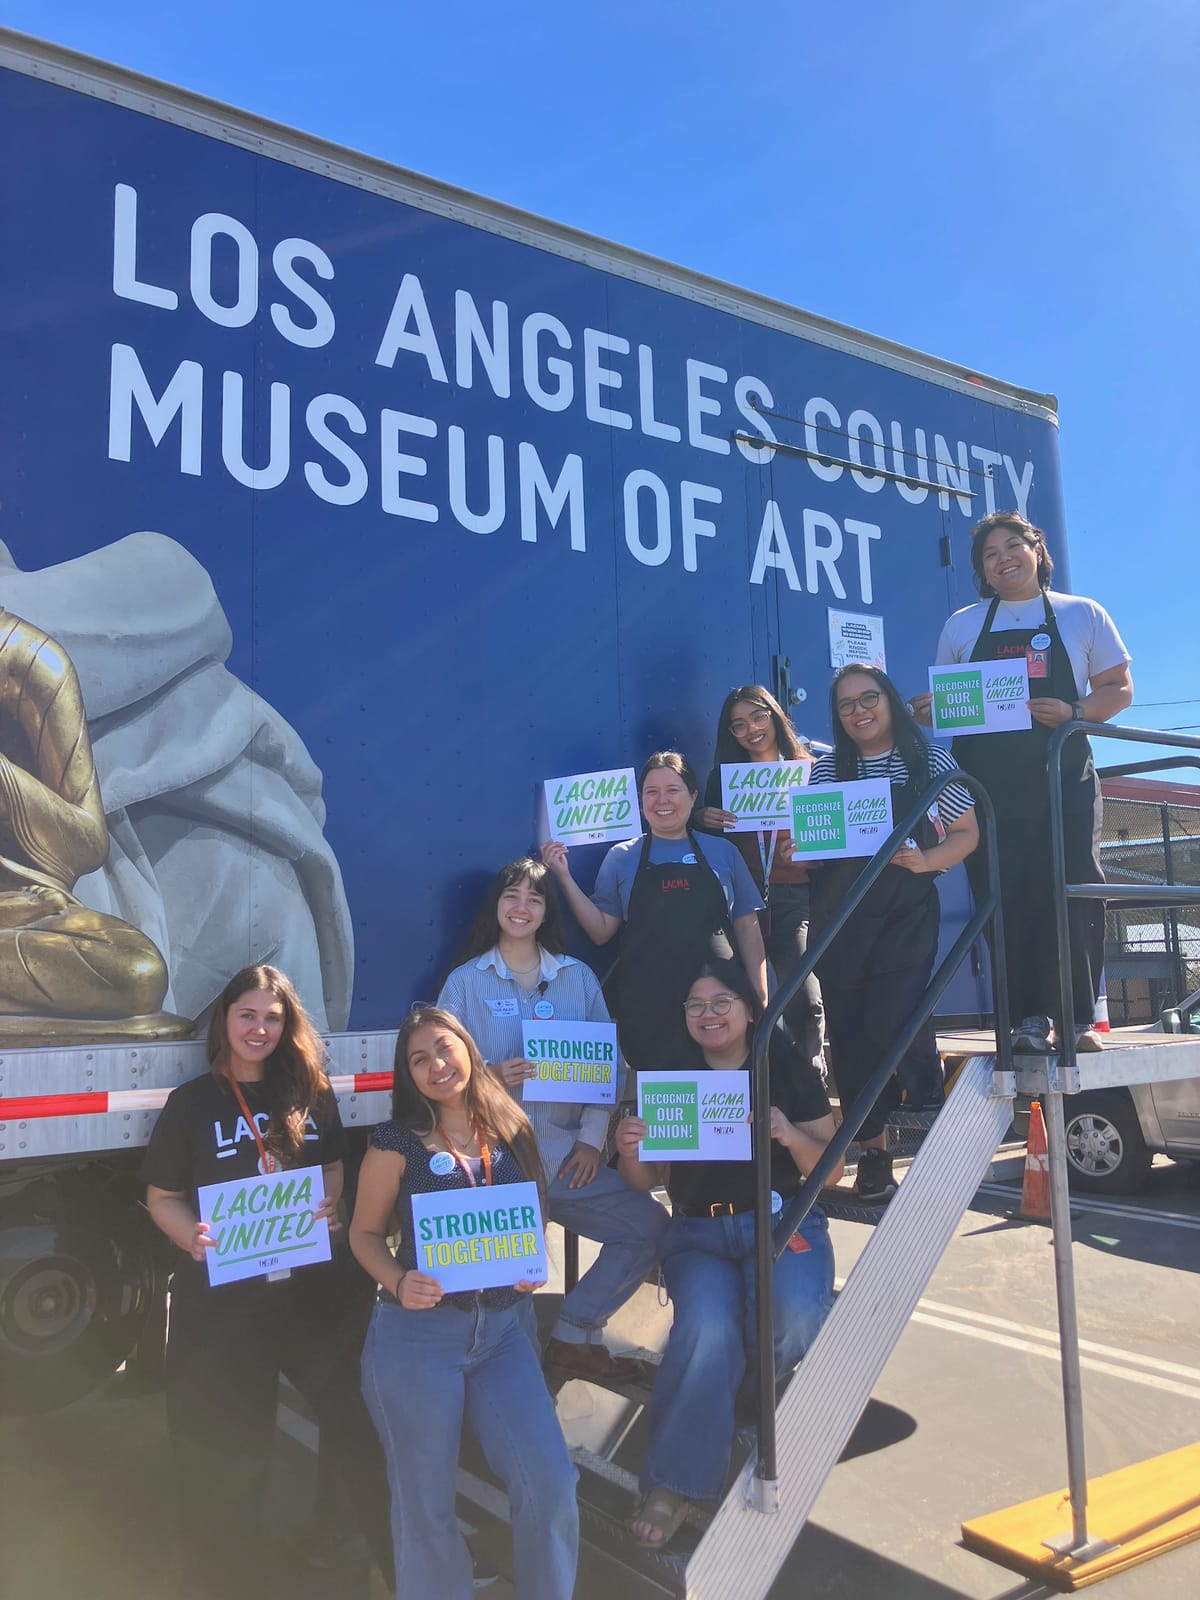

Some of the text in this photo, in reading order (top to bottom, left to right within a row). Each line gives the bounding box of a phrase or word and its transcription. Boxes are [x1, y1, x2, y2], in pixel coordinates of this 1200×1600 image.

[113, 183, 1034, 519] LOS ANGELES COUNTY
[108, 343, 881, 604] MUSEUM OF ART
[935, 680, 980, 692] RECOGNIZE
[986, 675, 1023, 688] LACMA
[946, 692, 970, 704] OUR
[987, 686, 1024, 699] UNITED
[941, 705, 979, 719] UNION!
[728, 766, 803, 790] LACMA
[553, 775, 628, 805] LACMA
[730, 791, 789, 813] UNITE
[796, 801, 841, 814] RECOGNIZE
[847, 797, 886, 811] LACMA
[556, 799, 632, 828] UNITED
[848, 810, 887, 822] UNITED
[807, 814, 832, 828] OUR
[800, 828, 840, 842] UNION!
[662, 880, 689, 889] LACMA
[527, 1039, 613, 1061] STRONGER
[644, 1093, 696, 1105] RECOGNIZE
[702, 1093, 744, 1106] LACMA
[656, 1107, 683, 1121] OUR
[702, 1107, 745, 1120] UNITED
[214, 1112, 318, 1148] LACA
[648, 1124, 693, 1139] UNION!
[211, 1175, 313, 1223] LACMA
[419, 1205, 537, 1241] STRONGER
[215, 1209, 316, 1256] UNITED
[423, 1232, 538, 1269] TOGETHER
